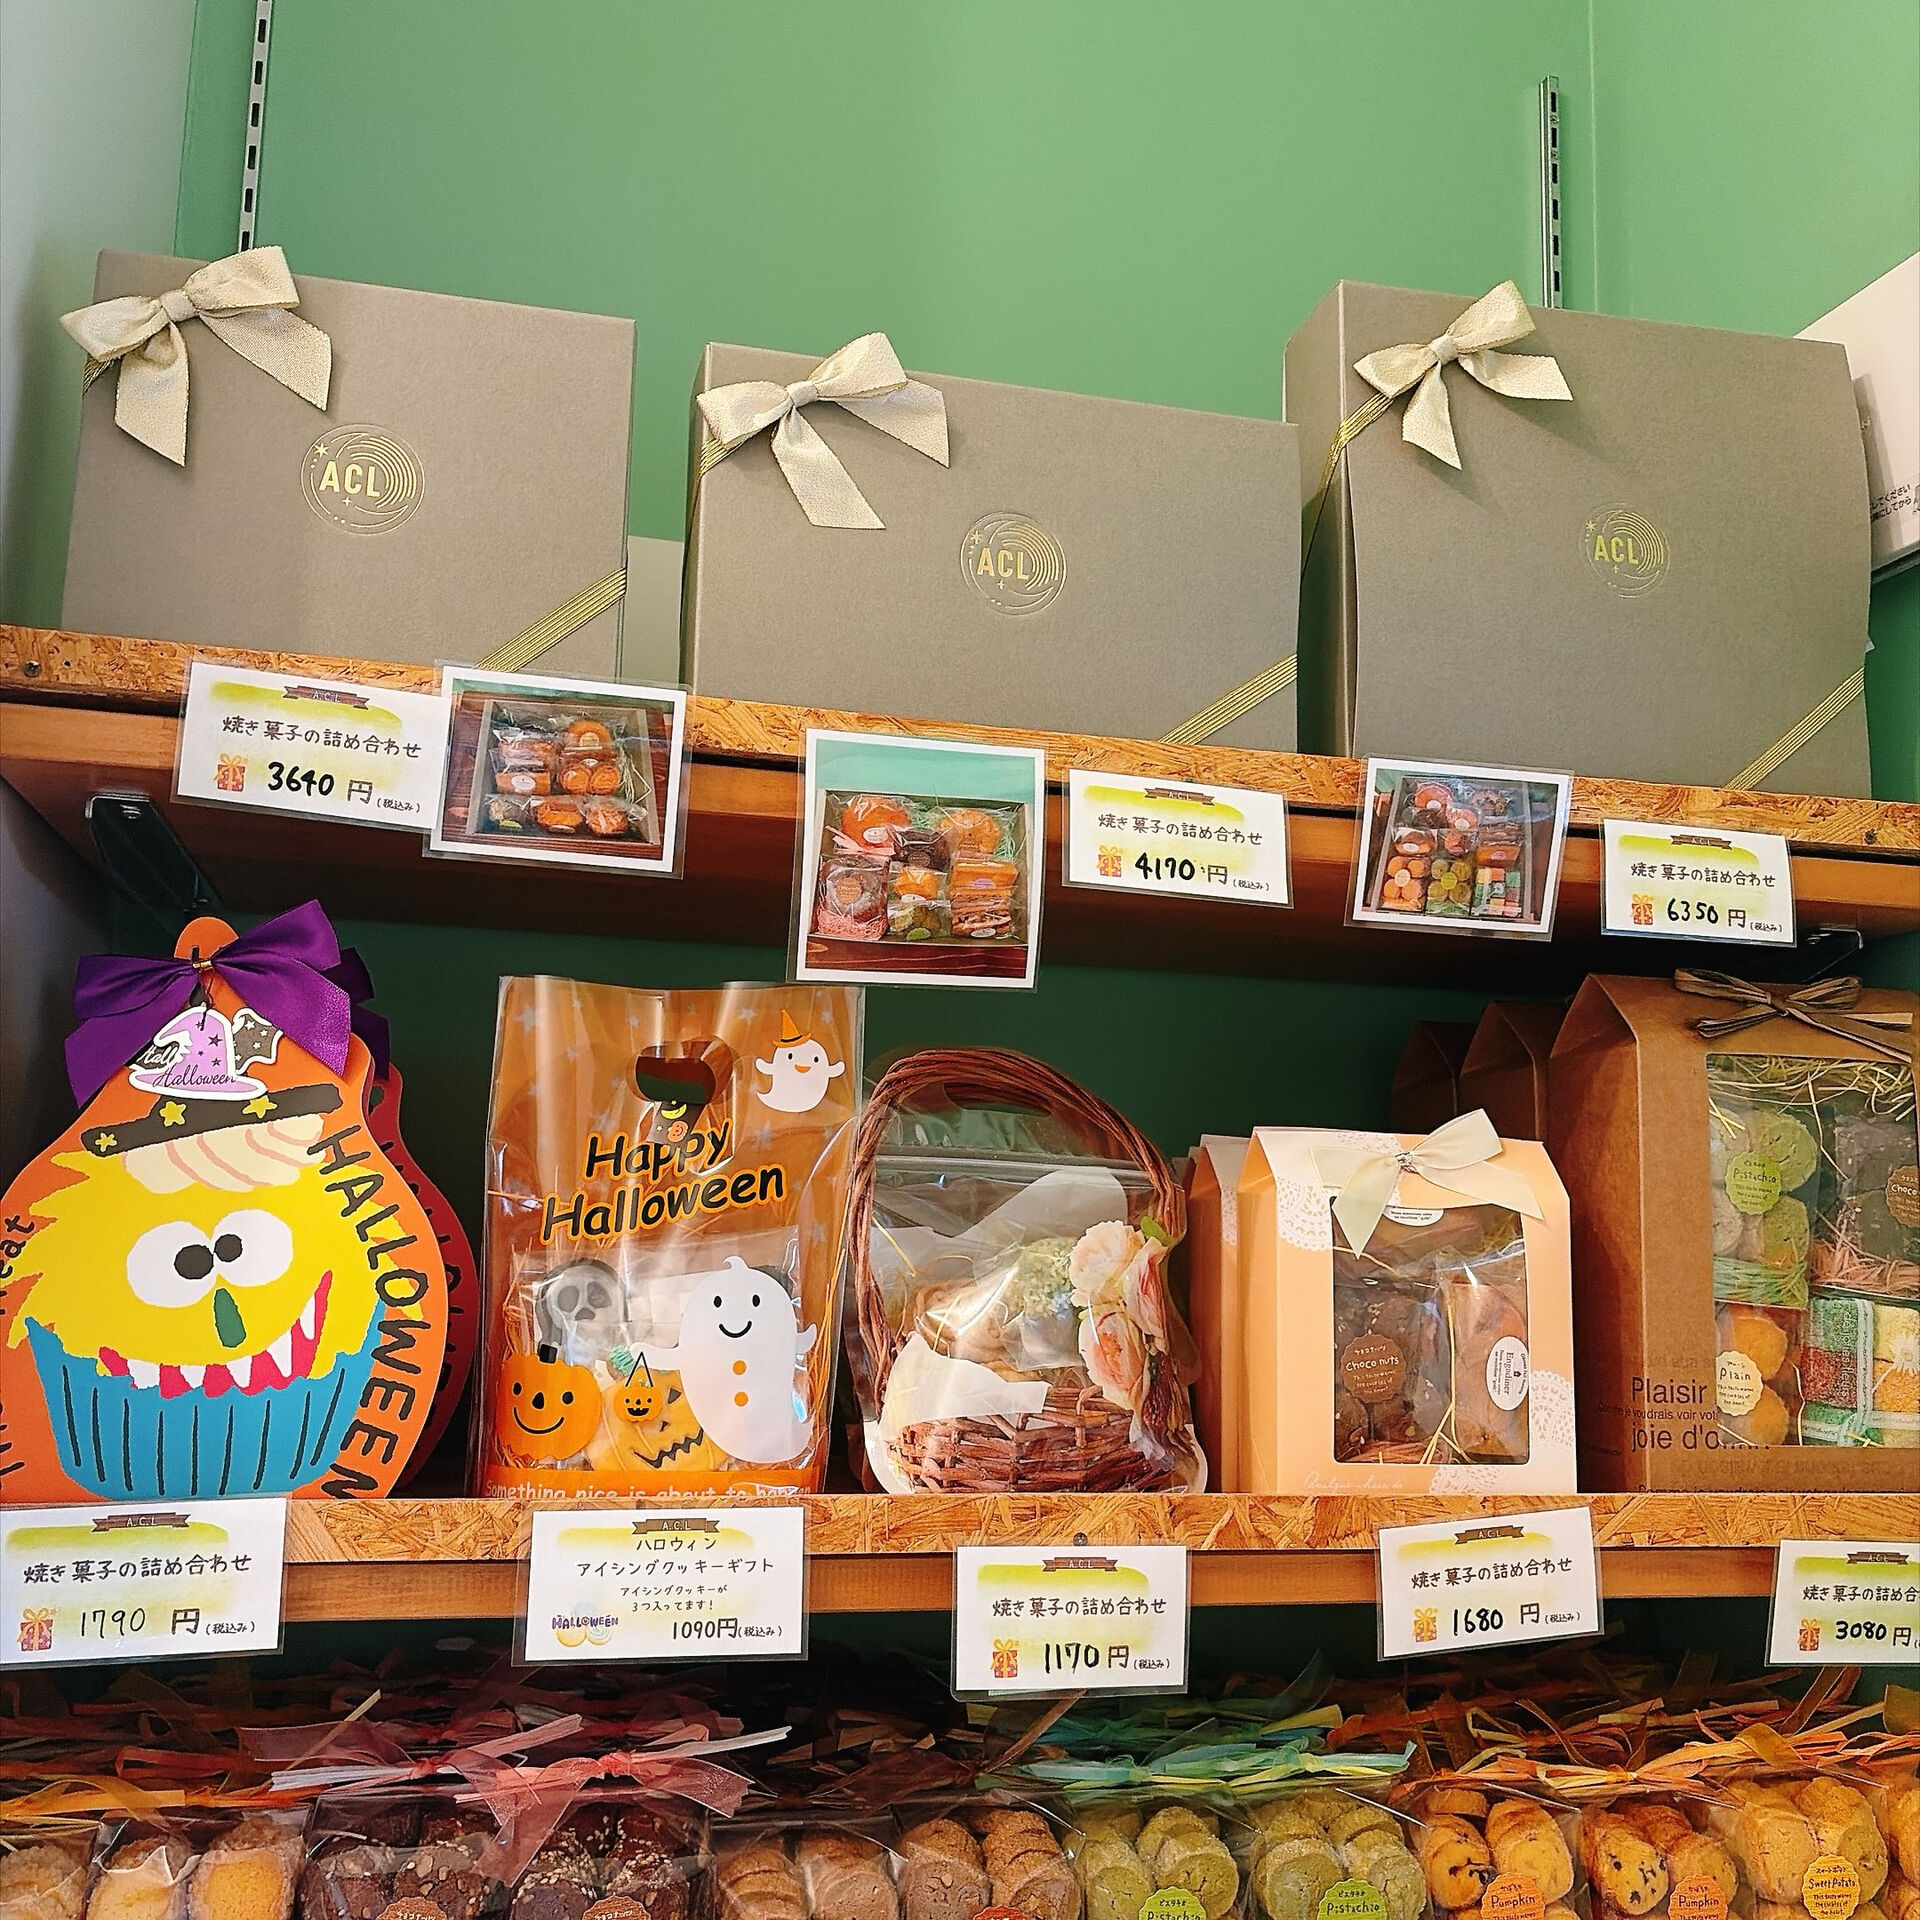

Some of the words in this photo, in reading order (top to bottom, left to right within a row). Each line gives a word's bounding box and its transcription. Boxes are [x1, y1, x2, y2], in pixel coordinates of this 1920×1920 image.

[318, 460, 381, 498] ACL
[976, 547, 1029, 580] ACL
[1593, 535, 1639, 565] ACL
[267, 762, 335, 796] 3640
[347, 779, 373, 805] 円
[1134, 852, 1196, 881] 4170
[1207, 865, 1228, 885] 円
[1667, 898, 1719, 924] 6350
[1727, 909, 1747, 928] 円
[152, 1063, 236, 1088] Halloween
[585, 1121, 731, 1181] Happy
[542, 1167, 784, 1242] Halloween
[1345, 1360, 1377, 1371] Choco
[1379, 1355, 1399, 1366] nuts
[1719, 1367, 1751, 1380] Plain
[1631, 1376, 1708, 1404] Plaisir
[1677, 1410, 1697, 1420] voir
[1631, 1422, 1673, 1452] joie
[636, 1536, 717, 1551] ハロウィン
[577, 1558, 774, 1577] アイシングクッキーギフト
[620, 1584, 728, 1598] アイシングクッキーが
[81, 1607, 146, 1639] 1790
[172, 1608, 200, 1635] 円
[552, 1615, 619, 1630] HALLOWEEN
[1453, 1608, 1504, 1636] 1680
[1520, 1602, 1540, 1625] 円
[1835, 1620, 1887, 1641] 3080
[1044, 1642, 1100, 1674] 1170
[1107, 1644, 1130, 1669] 円
[1327, 1900, 1380, 1916] Pistachio
[1491, 1893, 1536, 1908] Pumpkin
[1678, 1894, 1719, 1910] Pumpkin
